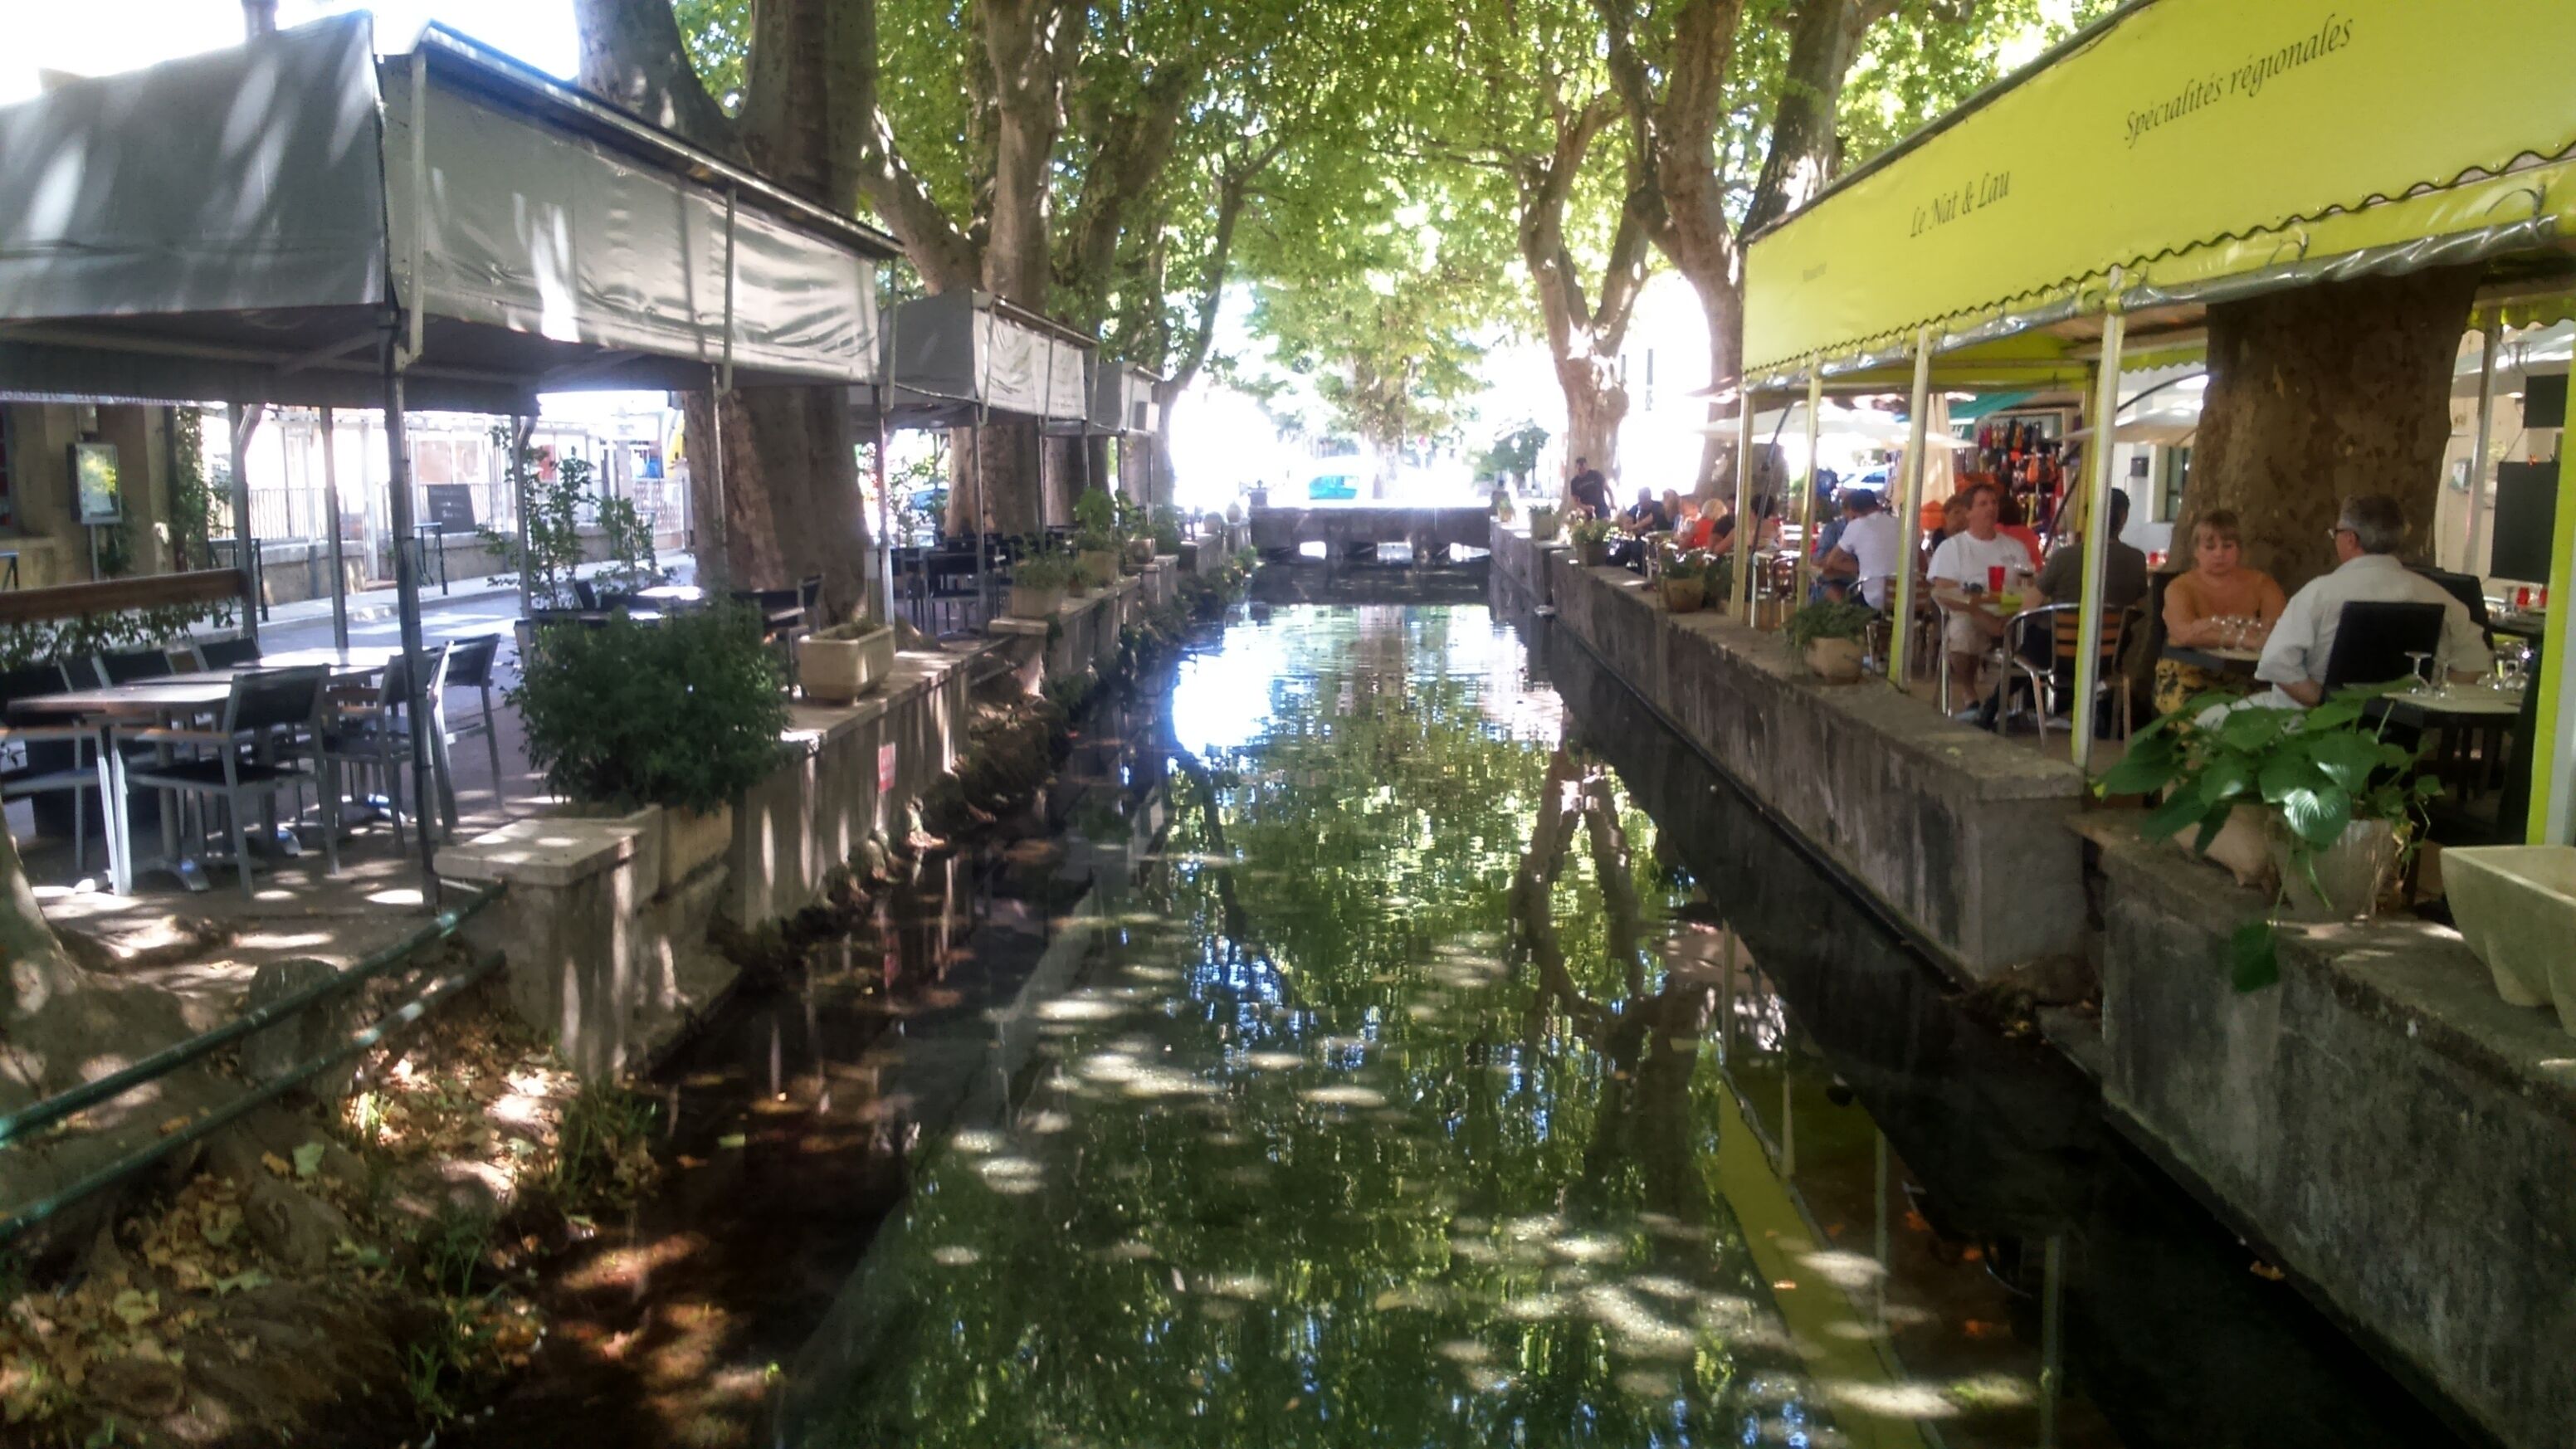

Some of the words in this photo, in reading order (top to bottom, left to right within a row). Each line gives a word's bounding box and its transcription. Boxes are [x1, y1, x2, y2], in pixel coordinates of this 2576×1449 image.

[2125, 73, 2224, 149] Spécialités
[2229, 12, 2354, 98] régionales
[1910, 206, 1926, 238] Le
[1928, 191, 1958, 230] Nat
[1961, 180, 1973, 215] &
[1977, 170, 2010, 208] Lau
